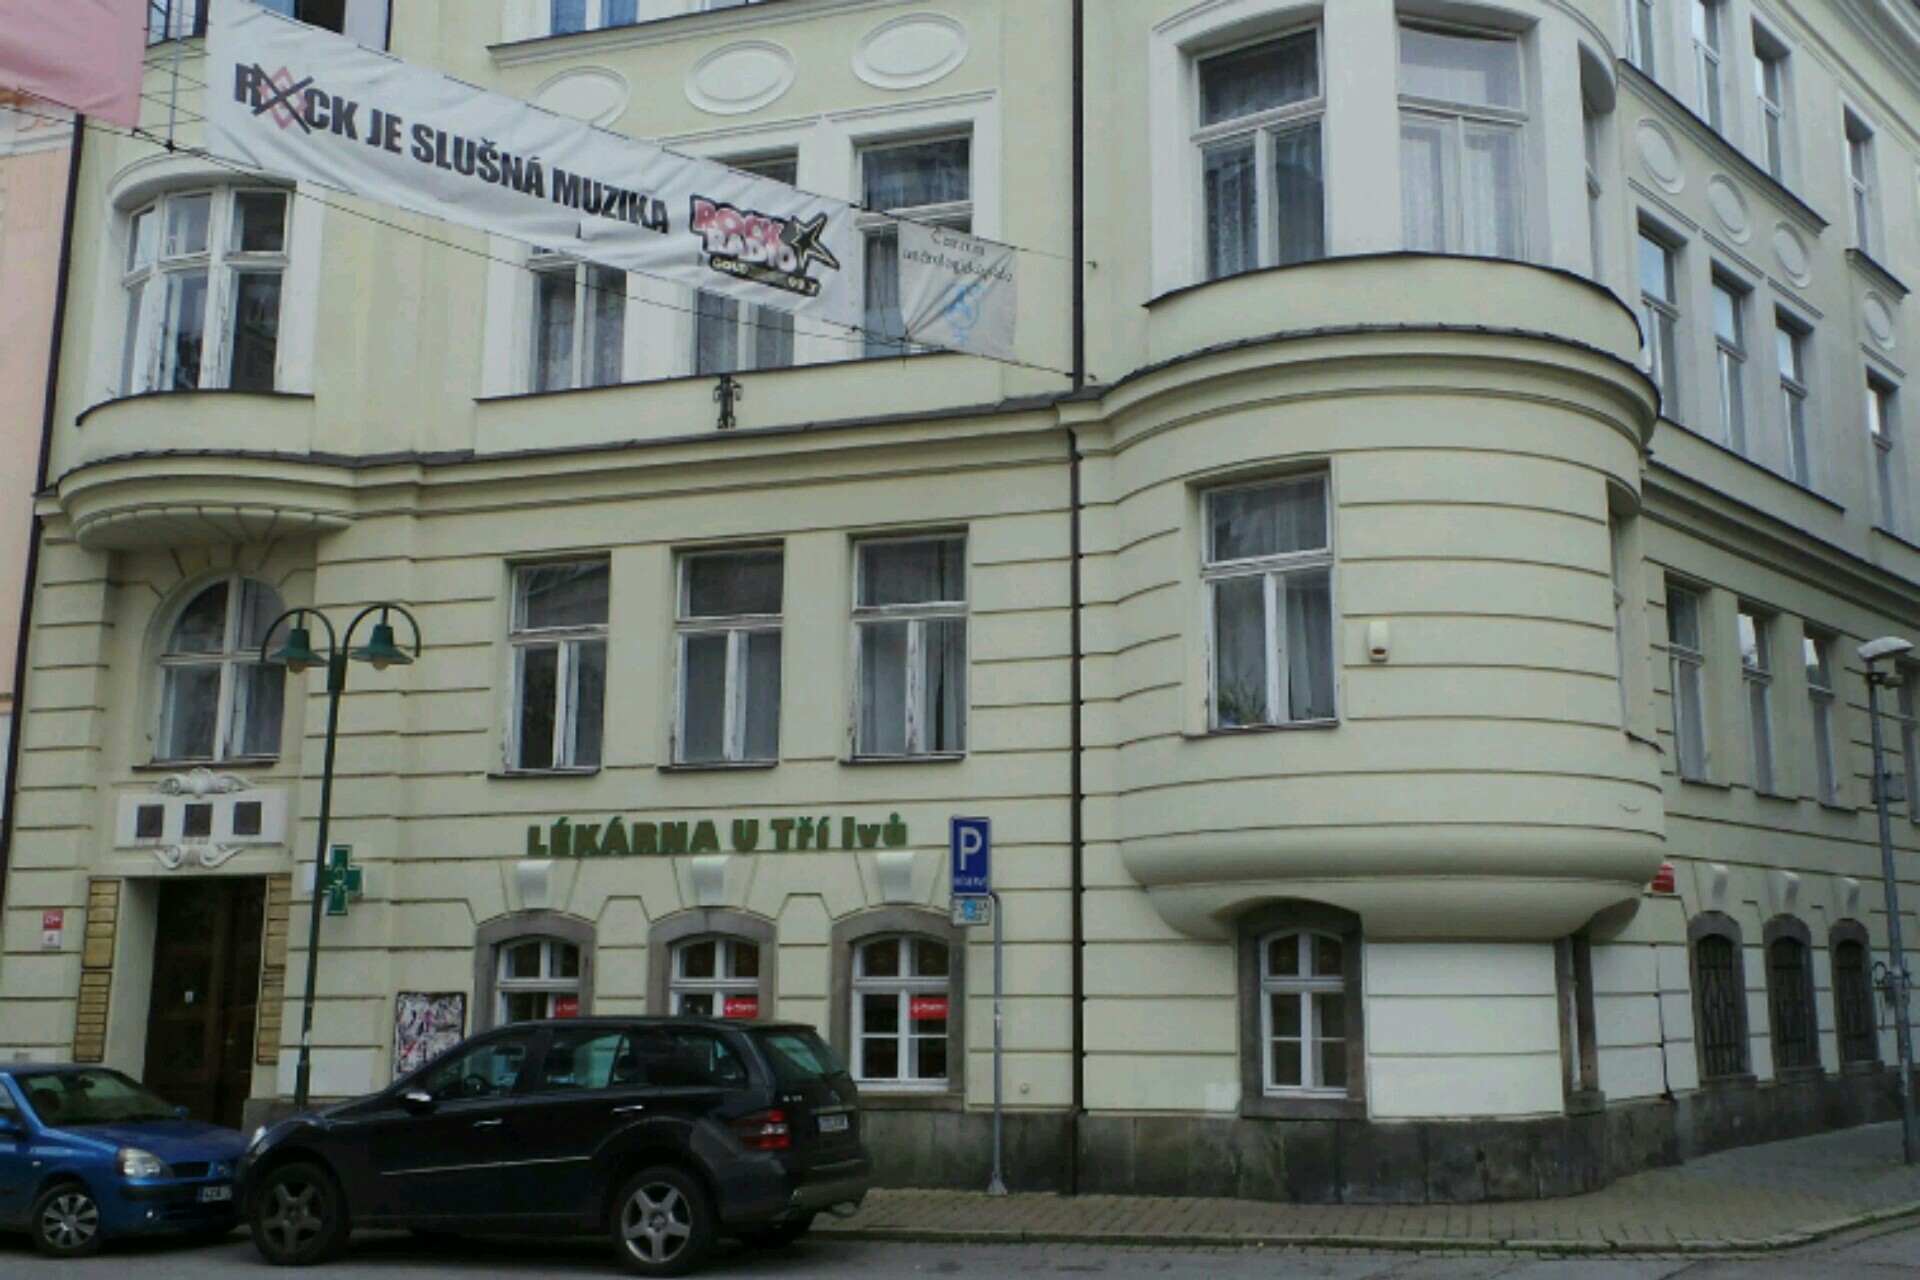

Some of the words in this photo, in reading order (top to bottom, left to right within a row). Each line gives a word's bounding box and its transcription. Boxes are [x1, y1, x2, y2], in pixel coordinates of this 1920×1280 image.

[366, 108, 403, 154] JE
[411, 122, 546, 198] SLUŠNÁ
[552, 166, 670, 234] MUZIKA
[693, 199, 785, 247] ROCK
[706, 227, 798, 272] RADIO
[527, 816, 720, 857] LÉKÁRNA
[732, 818, 760, 852] U
[770, 816, 830, 852] Tří
[959, 826, 982, 871] P
